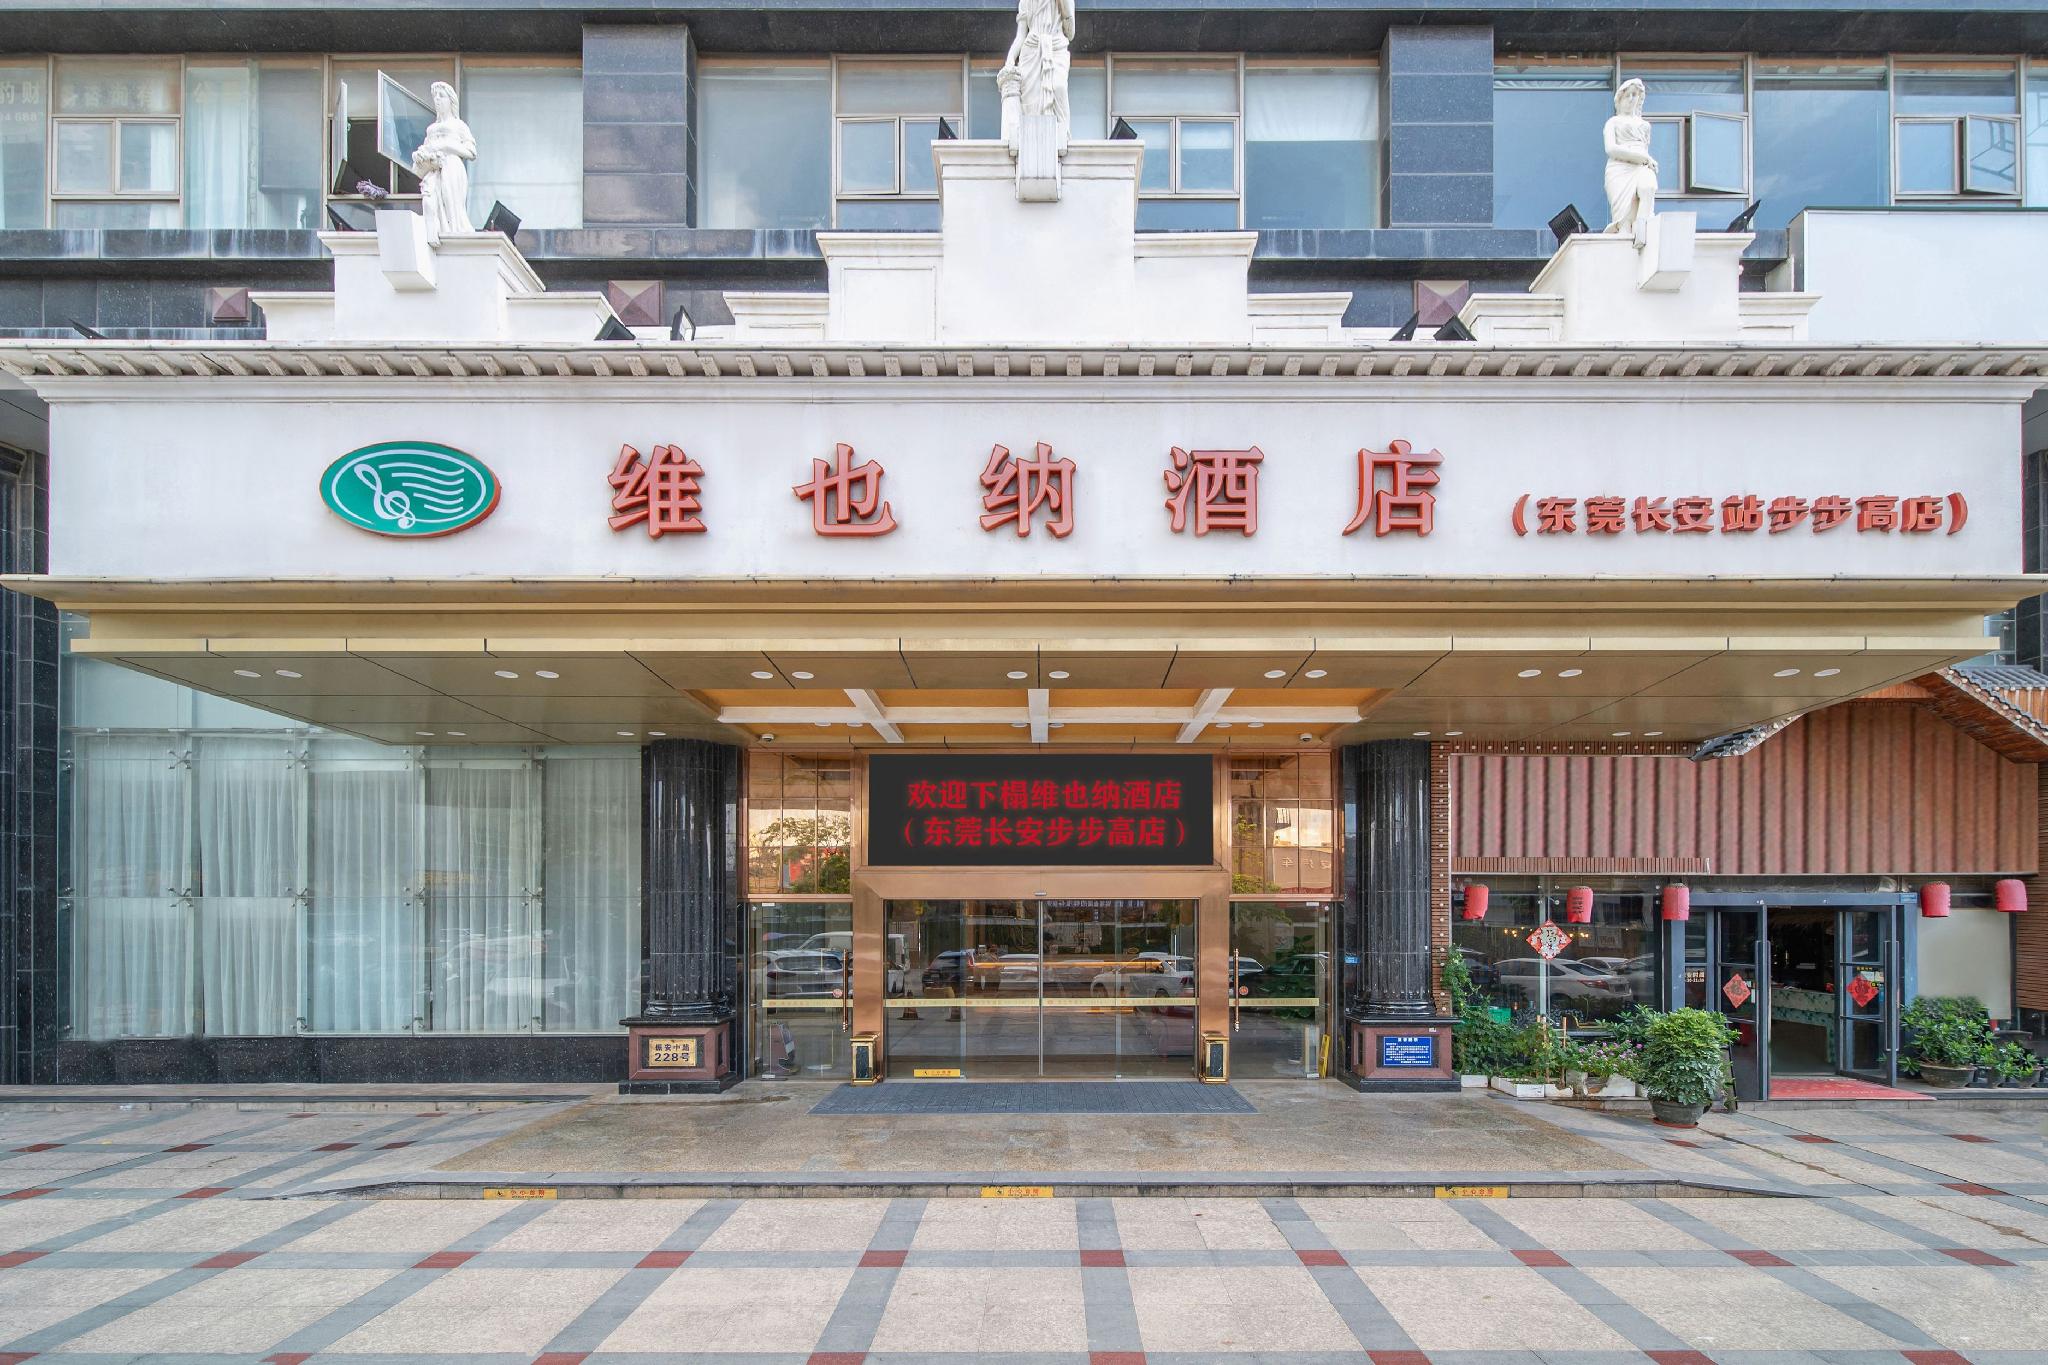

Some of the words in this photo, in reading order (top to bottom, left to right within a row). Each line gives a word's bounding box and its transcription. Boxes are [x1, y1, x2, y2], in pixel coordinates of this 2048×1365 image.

[607, 440, 1444, 540] 维也纳酒店
[1511, 492, 1969, 538] （东莞长安站步步高店）
[907, 780, 1183, 810] 欢迎下榻维也纳酒店
[904, 816, 1187, 848] （东莞长安步步高店）
[654, 1052, 690, 1062] 228号
